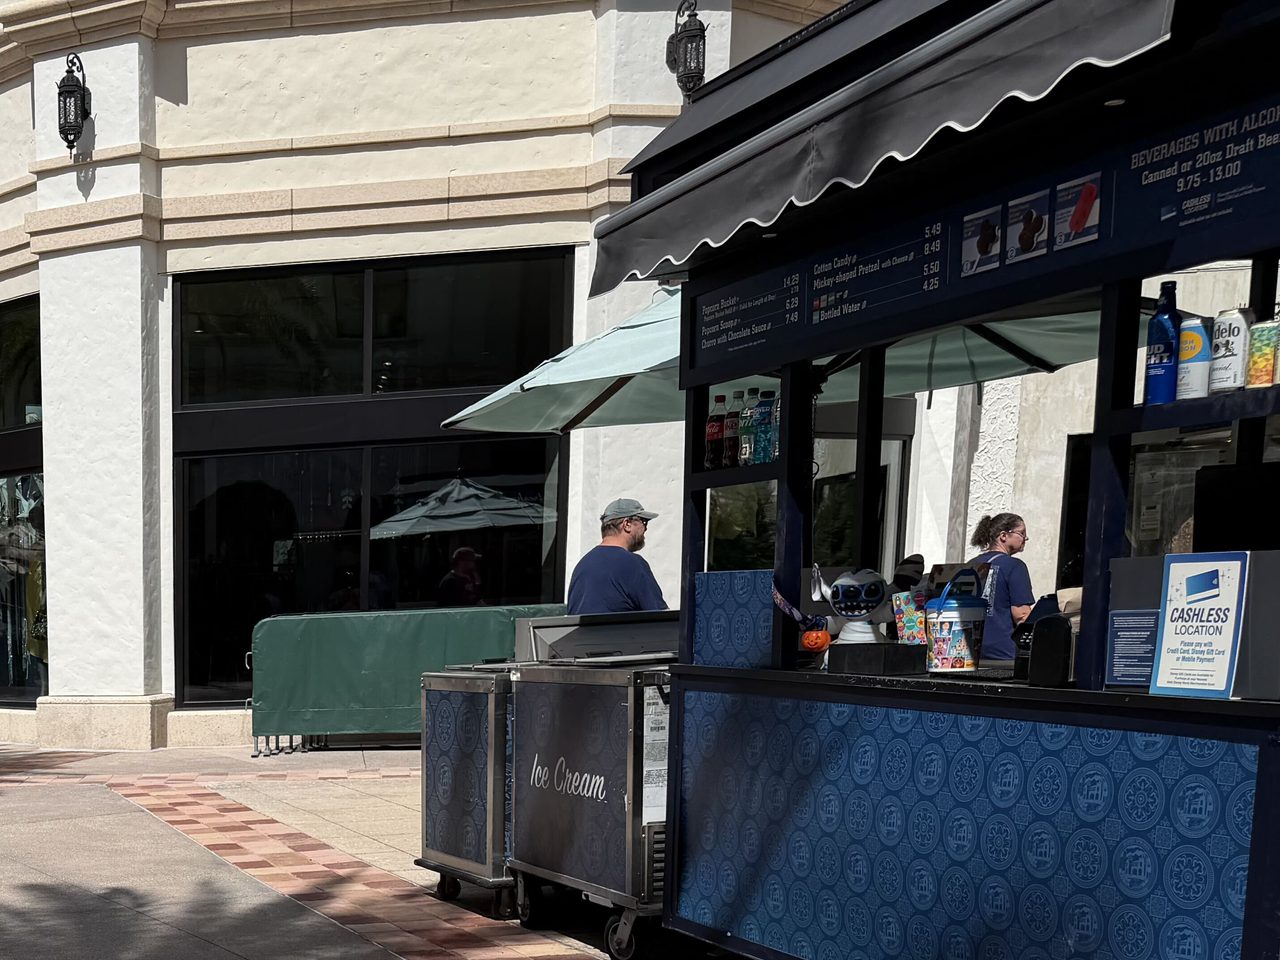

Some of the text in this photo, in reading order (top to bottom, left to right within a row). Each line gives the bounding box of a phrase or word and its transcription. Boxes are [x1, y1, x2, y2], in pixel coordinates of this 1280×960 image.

[1131, 132, 1200, 170] BEVERAGES
[1203, 119, 1238, 145] WITH
[1141, 133, 1280, 185] Canned or 20oz Draft Bee
[924, 222, 941, 238] 5.49
[924, 239, 941, 255] 8.49
[813, 254, 852, 275] Cotton Candy
[923, 260, 940, 276] 5.50
[813, 267, 857, 290] Mickey-shaped
[858, 259, 880, 276] Pretzel
[922, 277, 939, 292] 4.25
[702, 303, 719, 315] Popcorn
[820, 303, 861, 321] Bottled Water
[702, 325, 719, 336] Popcorn
[728, 327, 751, 341] Chocolate
[1214, 323, 1240, 340] delo
[1170, 607, 1230, 624] CASHLESS
[1175, 624, 1222, 636] LOCATION
[530, 753, 550, 789] Ice
[554, 756, 606, 800] Cream
